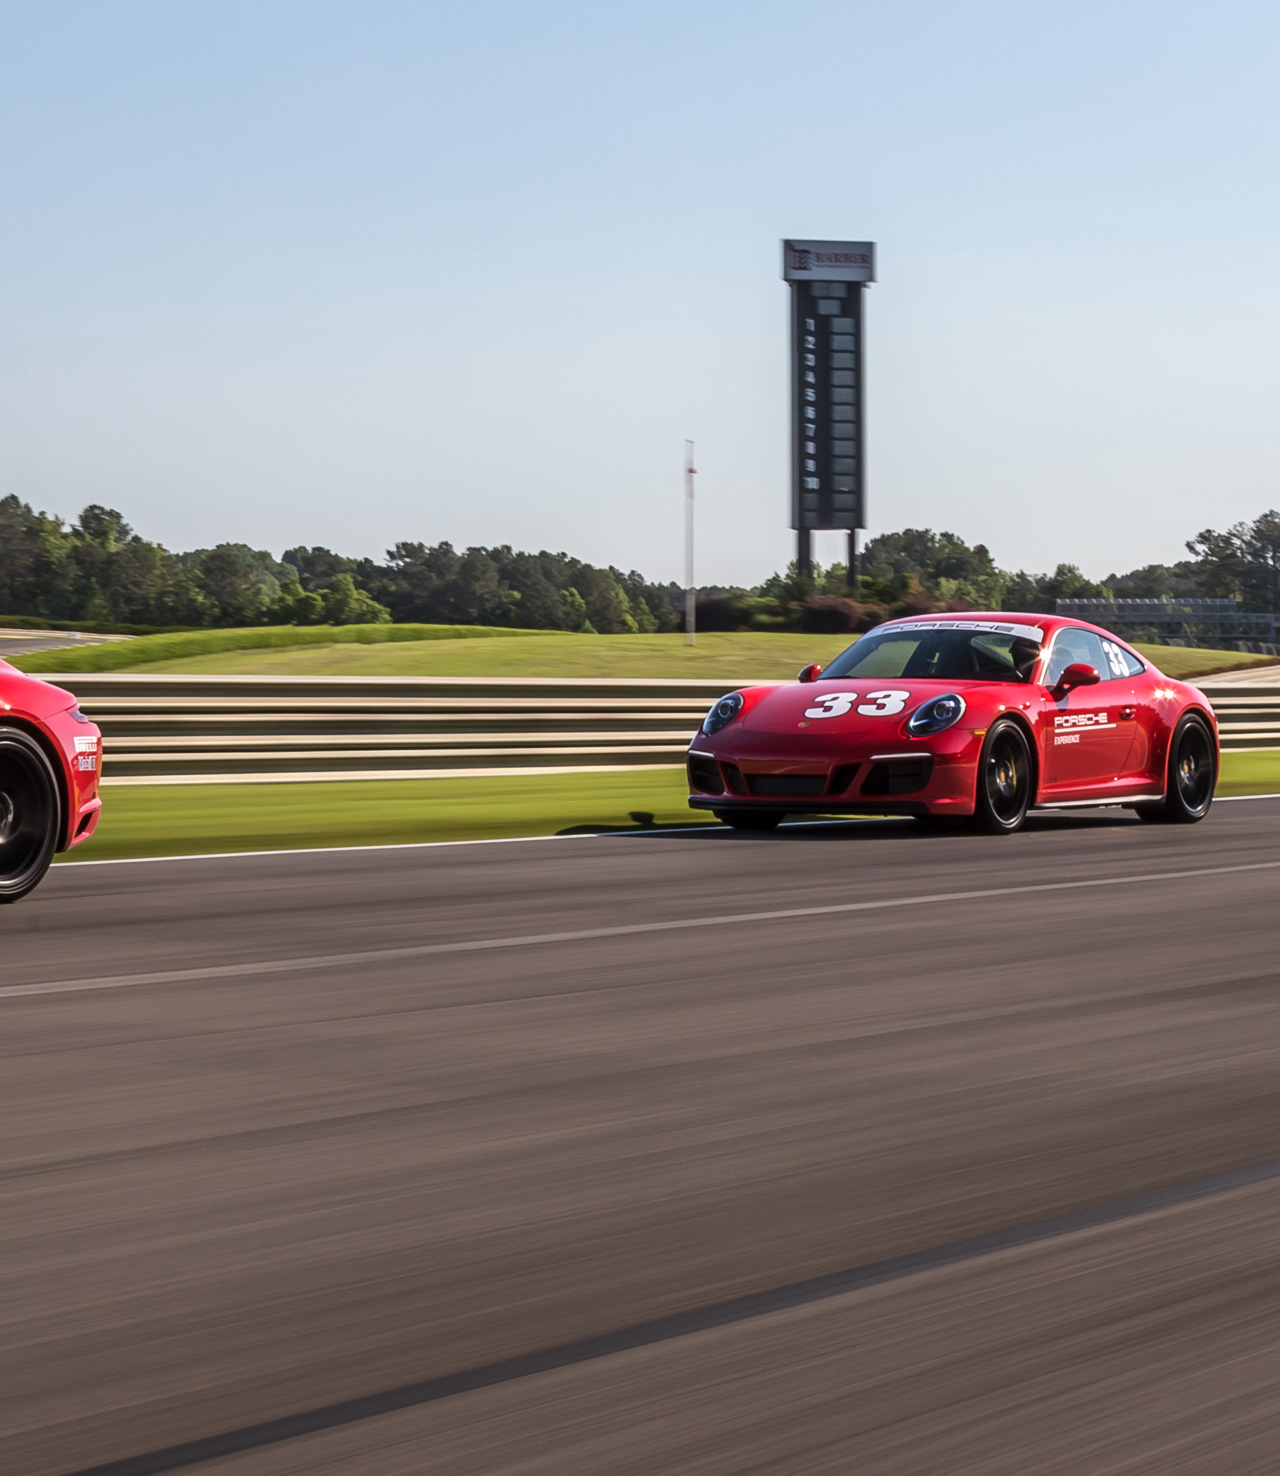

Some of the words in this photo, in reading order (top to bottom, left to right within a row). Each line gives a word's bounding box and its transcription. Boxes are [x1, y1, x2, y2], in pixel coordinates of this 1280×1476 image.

[805, 318, 815, 331] 1
[804, 336, 816, 349] 2
[804, 353, 816, 367] 3
[804, 371, 816, 384] 4
[804, 388, 816, 401] 5
[804, 406, 816, 419] 6
[804, 423, 816, 437] 7
[804, 441, 816, 454] 8
[804, 459, 816, 472] 9
[802, 477, 820, 489] 10
[882, 622, 1015, 633] PORSCHE
[1102, 641, 1130, 677] 33
[803, 689, 912, 719] 33
[1054, 712, 1108, 728] PORSCHE
